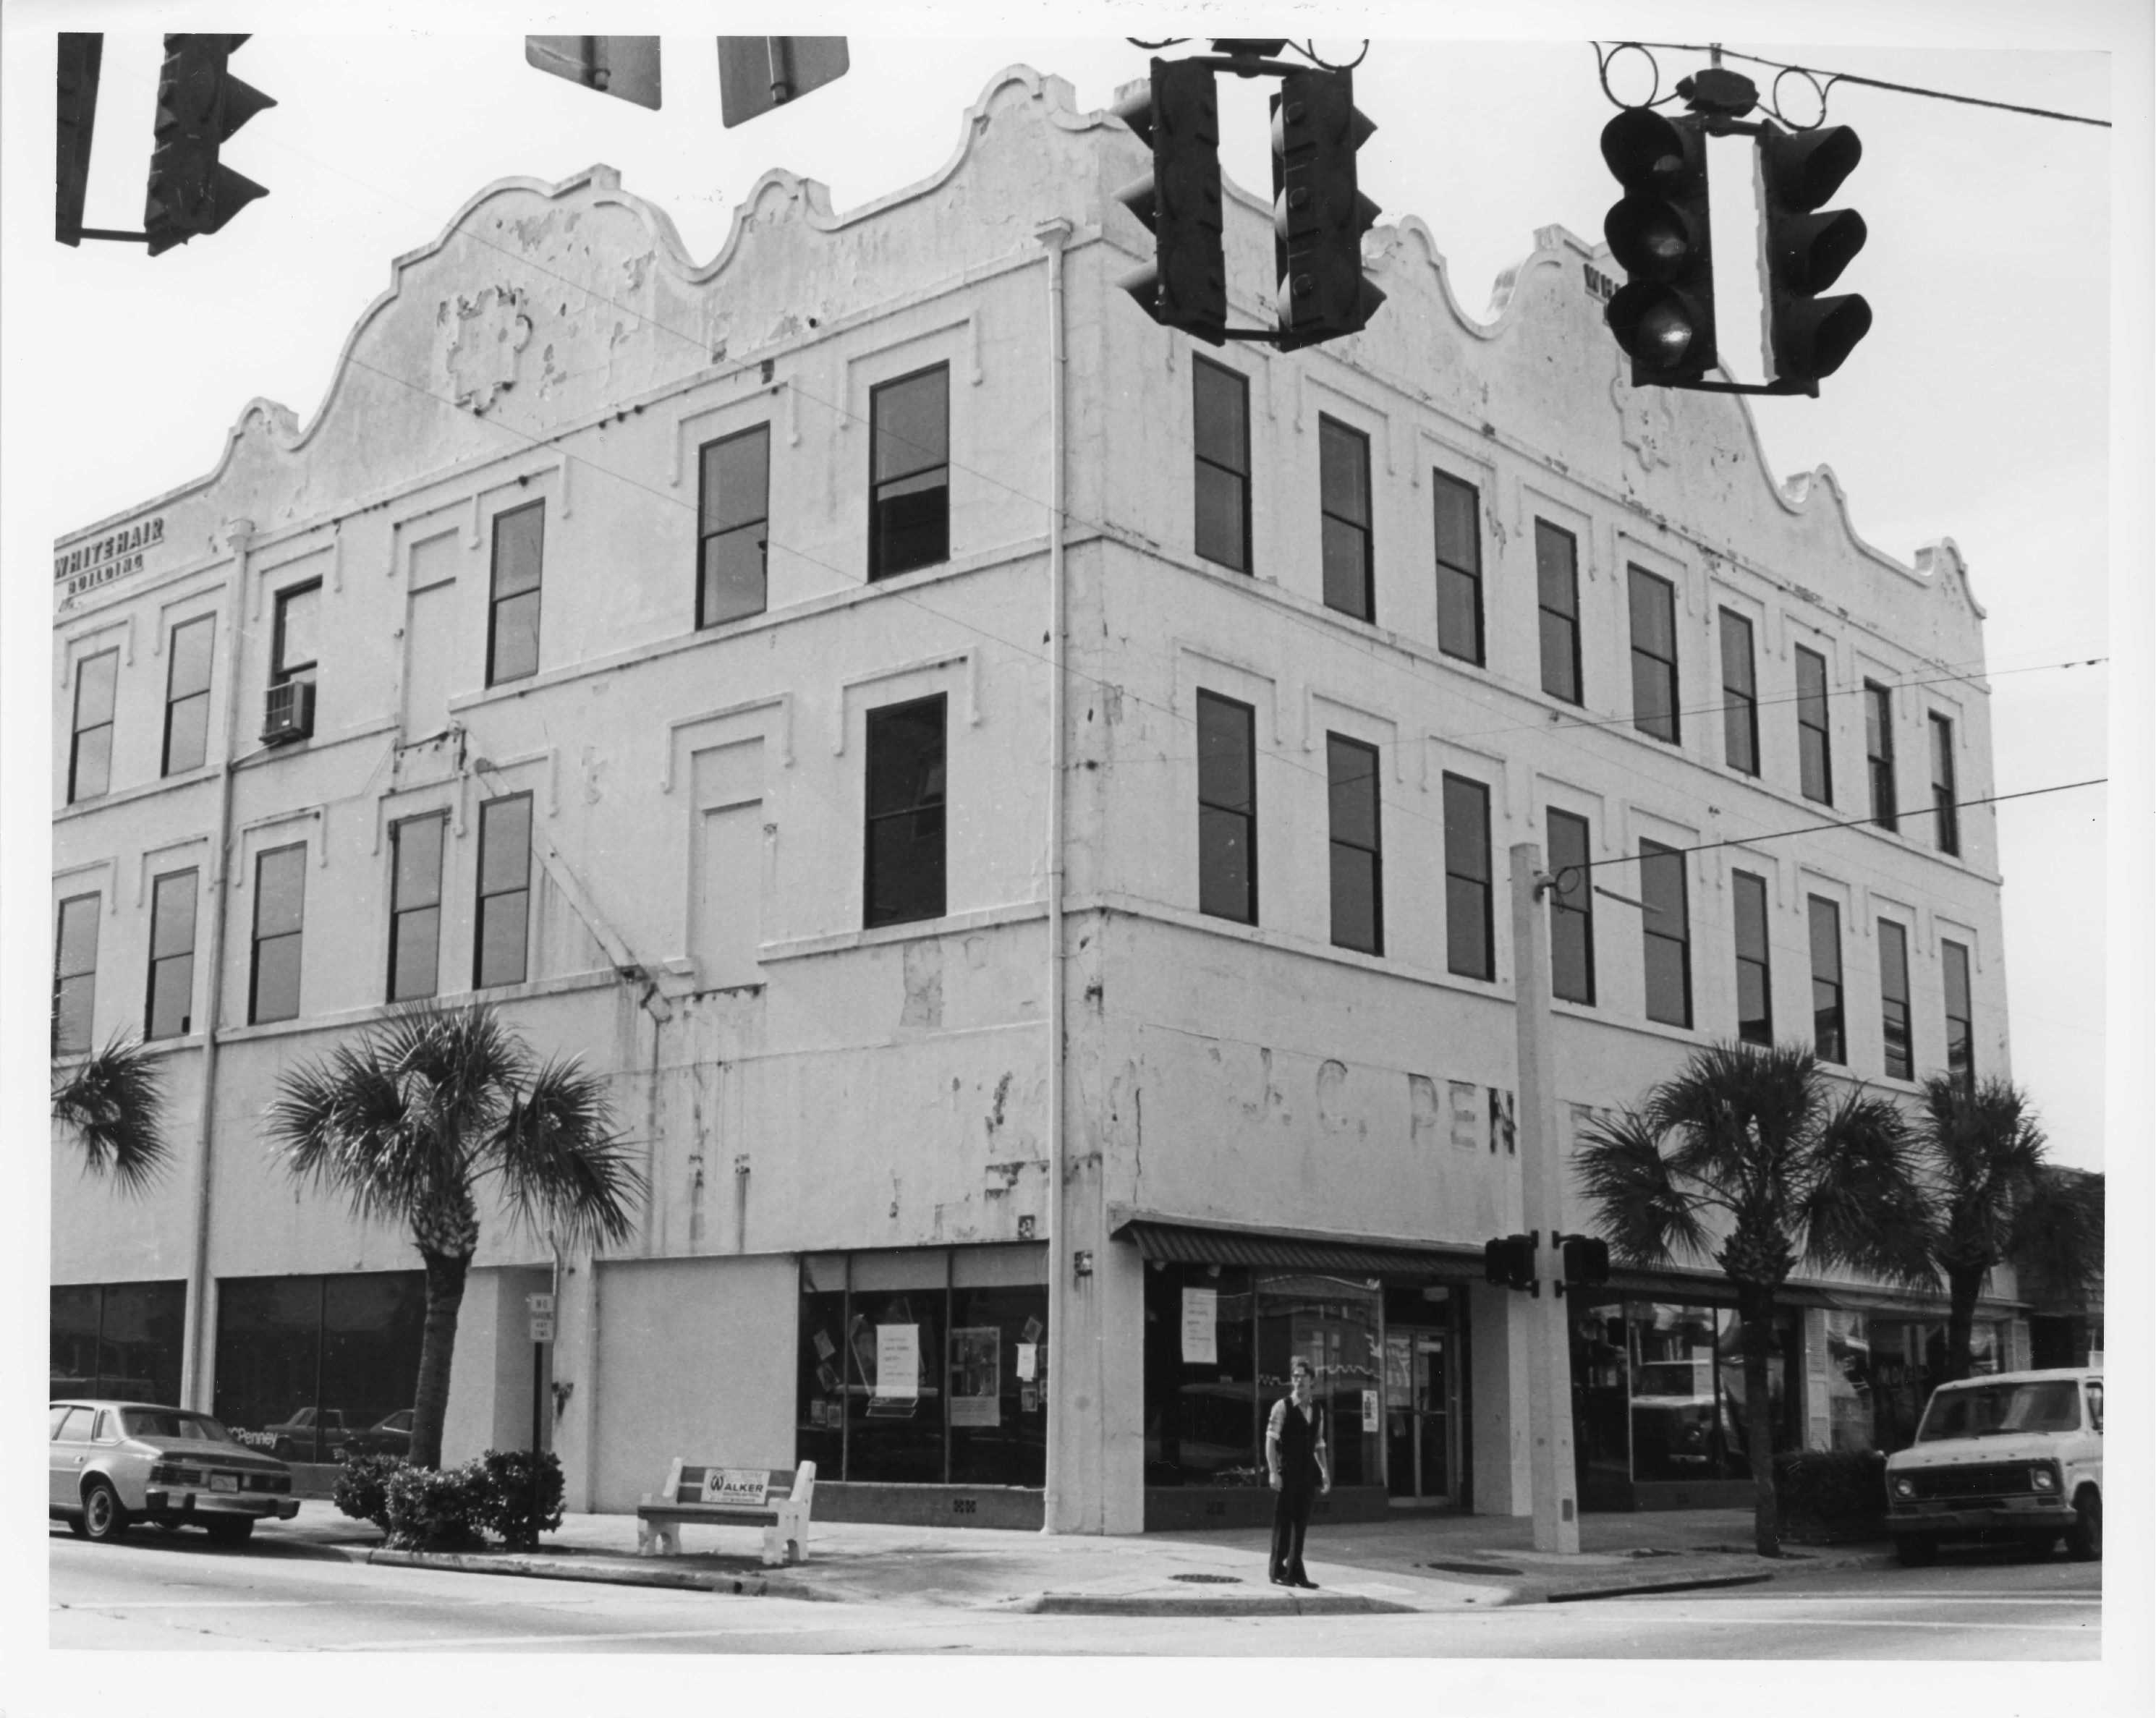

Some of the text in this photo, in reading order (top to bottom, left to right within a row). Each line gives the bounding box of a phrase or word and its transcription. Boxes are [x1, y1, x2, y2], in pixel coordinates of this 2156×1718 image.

[55, 516, 164, 579] WHITEHAIR
[69, 553, 143, 595] BUILDING
[710, 1475, 763, 1492] WALKER
